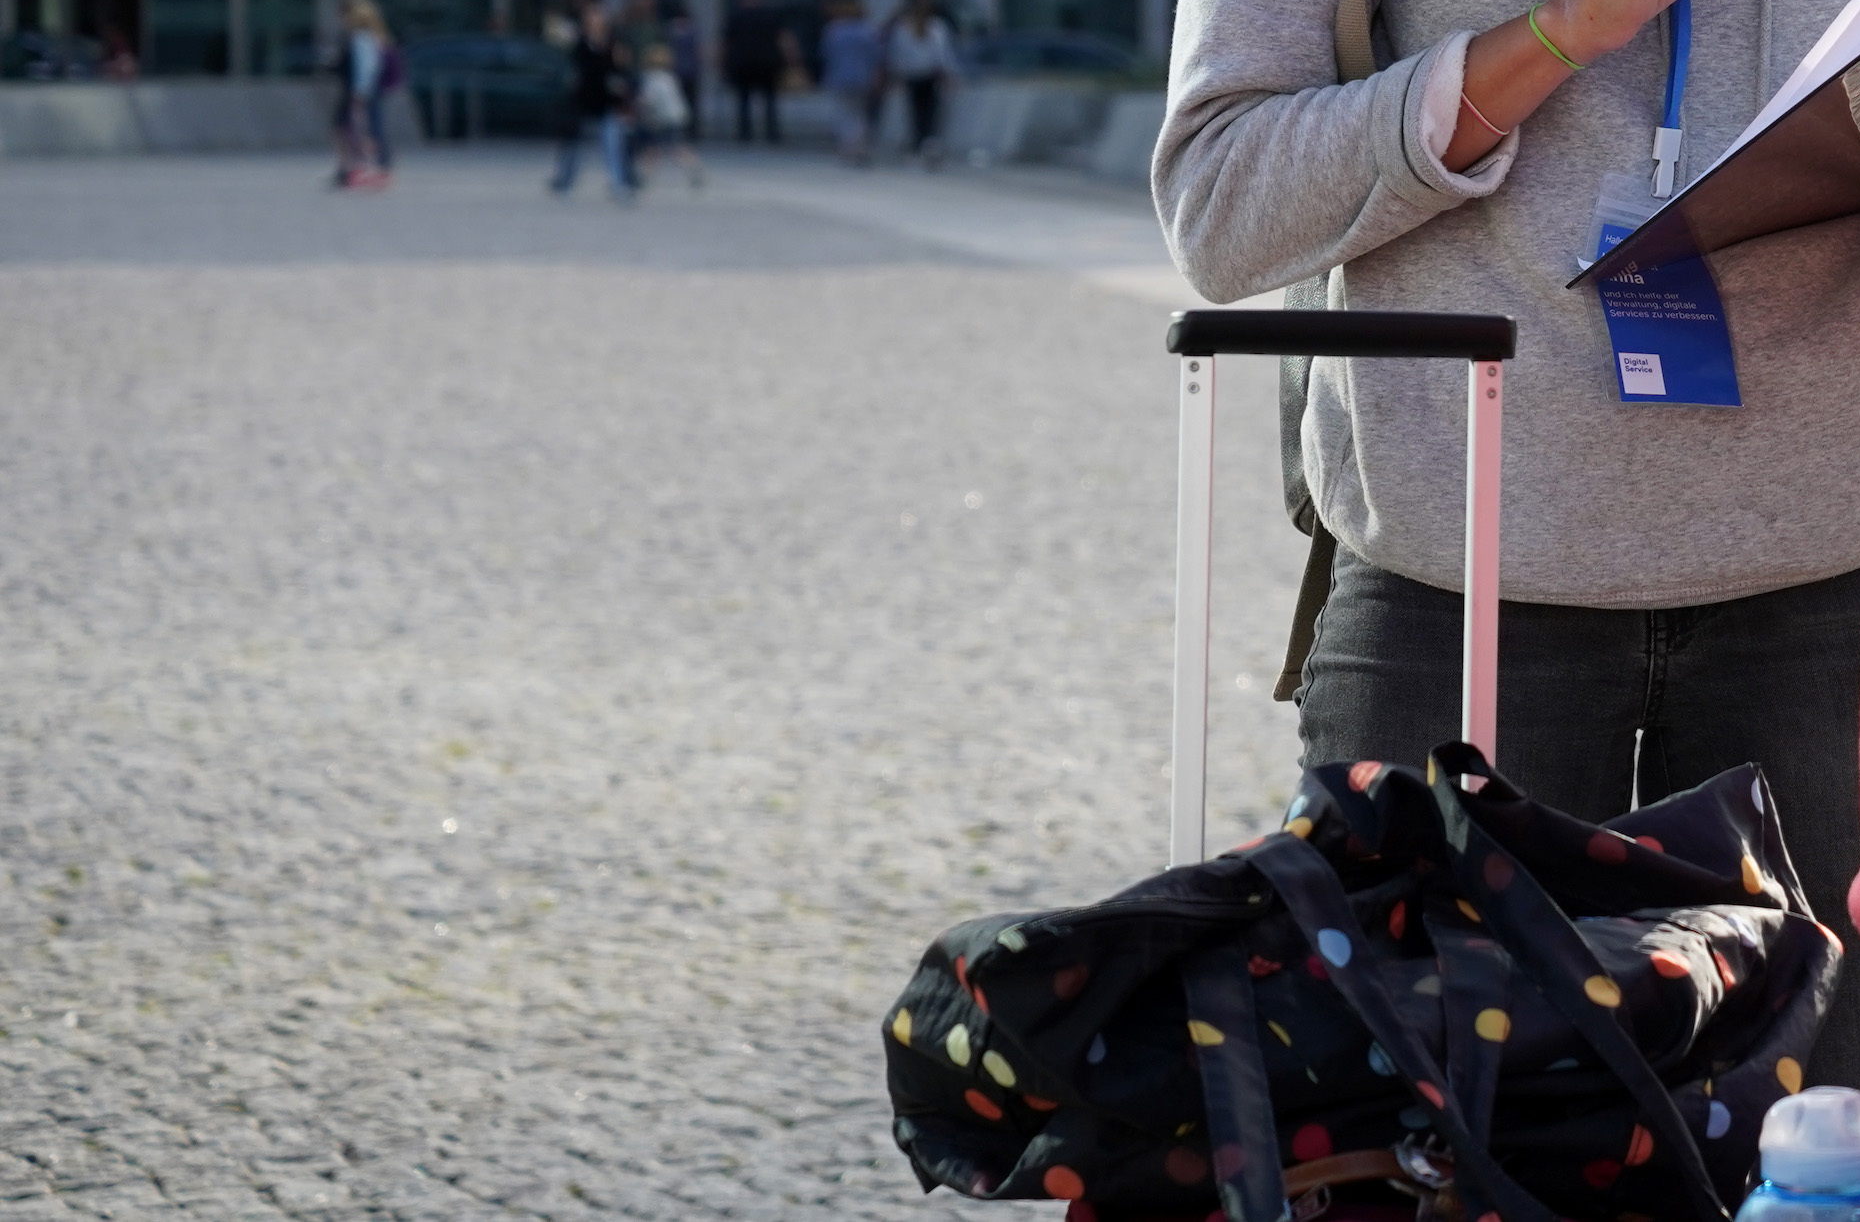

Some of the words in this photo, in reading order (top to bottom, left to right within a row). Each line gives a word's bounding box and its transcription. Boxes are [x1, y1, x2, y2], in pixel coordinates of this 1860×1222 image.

[1604, 290, 1621, 298] und
[1623, 291, 1637, 299] ich
[1639, 291, 1662, 300] helfe
[1606, 300, 1662, 310] Verwaltung,
[1663, 301, 1697, 311] digitale
[1610, 309, 1649, 318] Services
[1665, 311, 1718, 321] verbessern.
[1624, 358, 1649, 366] Digital
